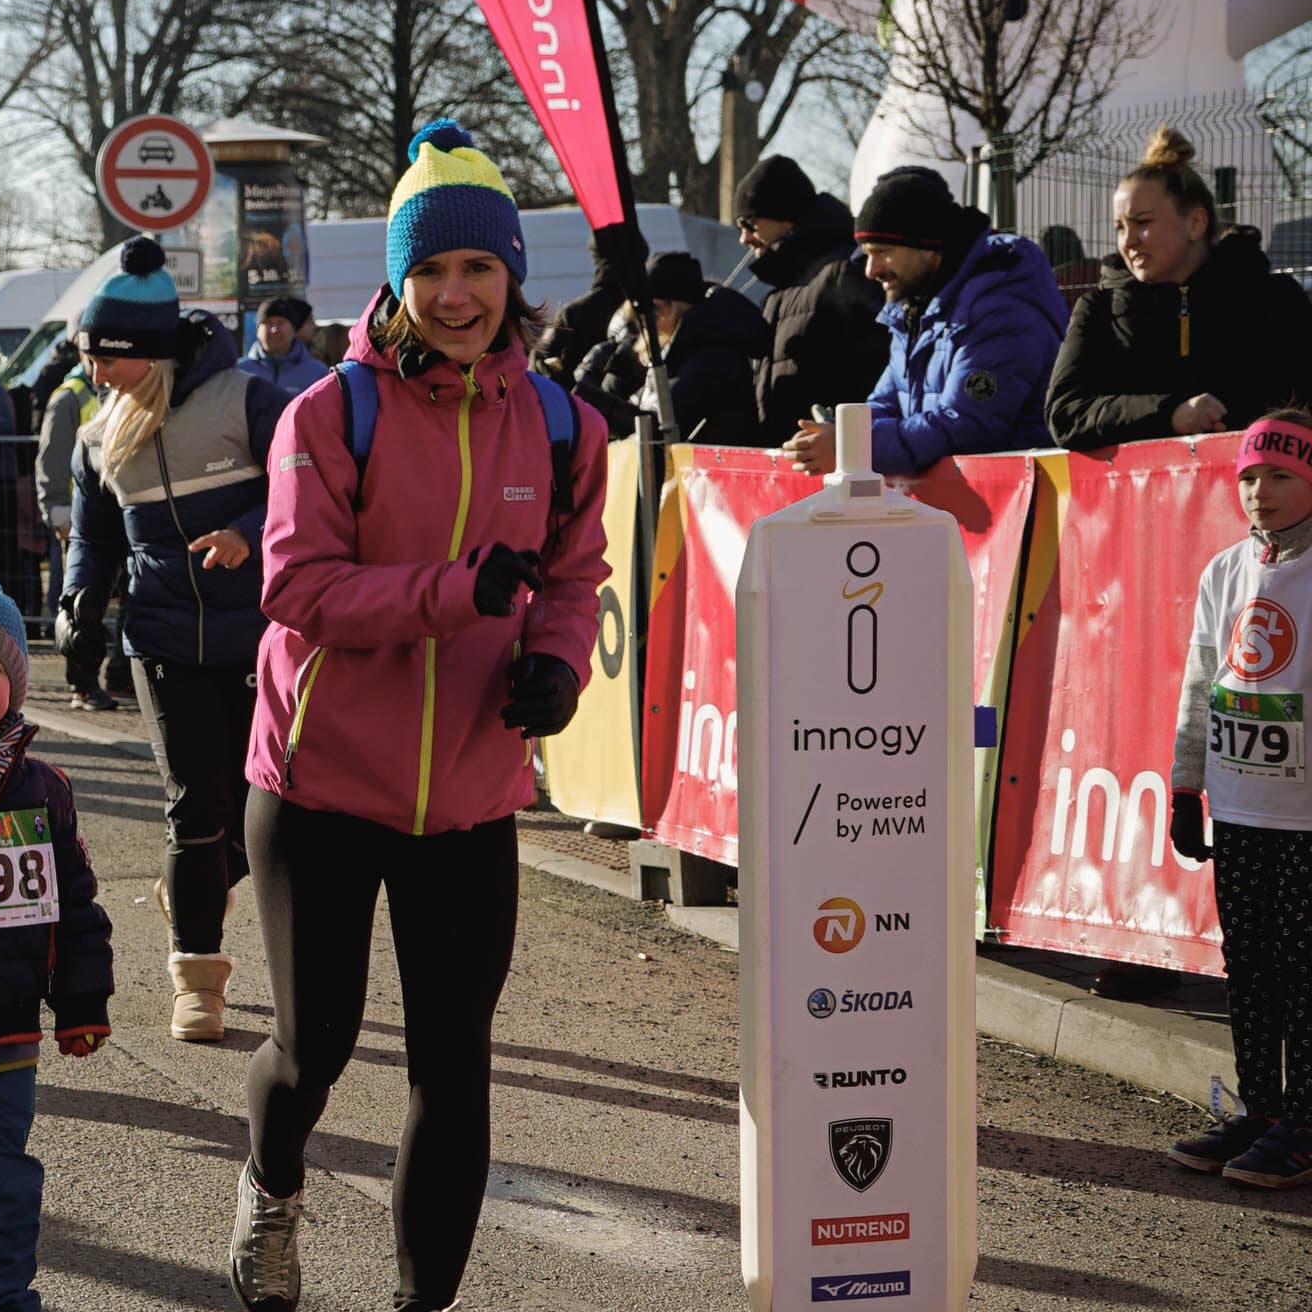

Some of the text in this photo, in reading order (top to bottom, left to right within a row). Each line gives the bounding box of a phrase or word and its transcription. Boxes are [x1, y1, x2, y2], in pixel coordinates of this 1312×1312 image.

[793, 719, 927, 756] innogy
[1210, 714, 1290, 763] 3179
[837, 789, 927, 812] Powered
[836, 816, 926, 843] by MVM
[875, 913, 911, 931] NN
[840, 989, 914, 1014] ŠKODA
[831, 1068, 908, 1089] RUNTO
[835, 1123, 887, 1135] PEUGEOT
[817, 1219, 907, 1240] NUTREND
